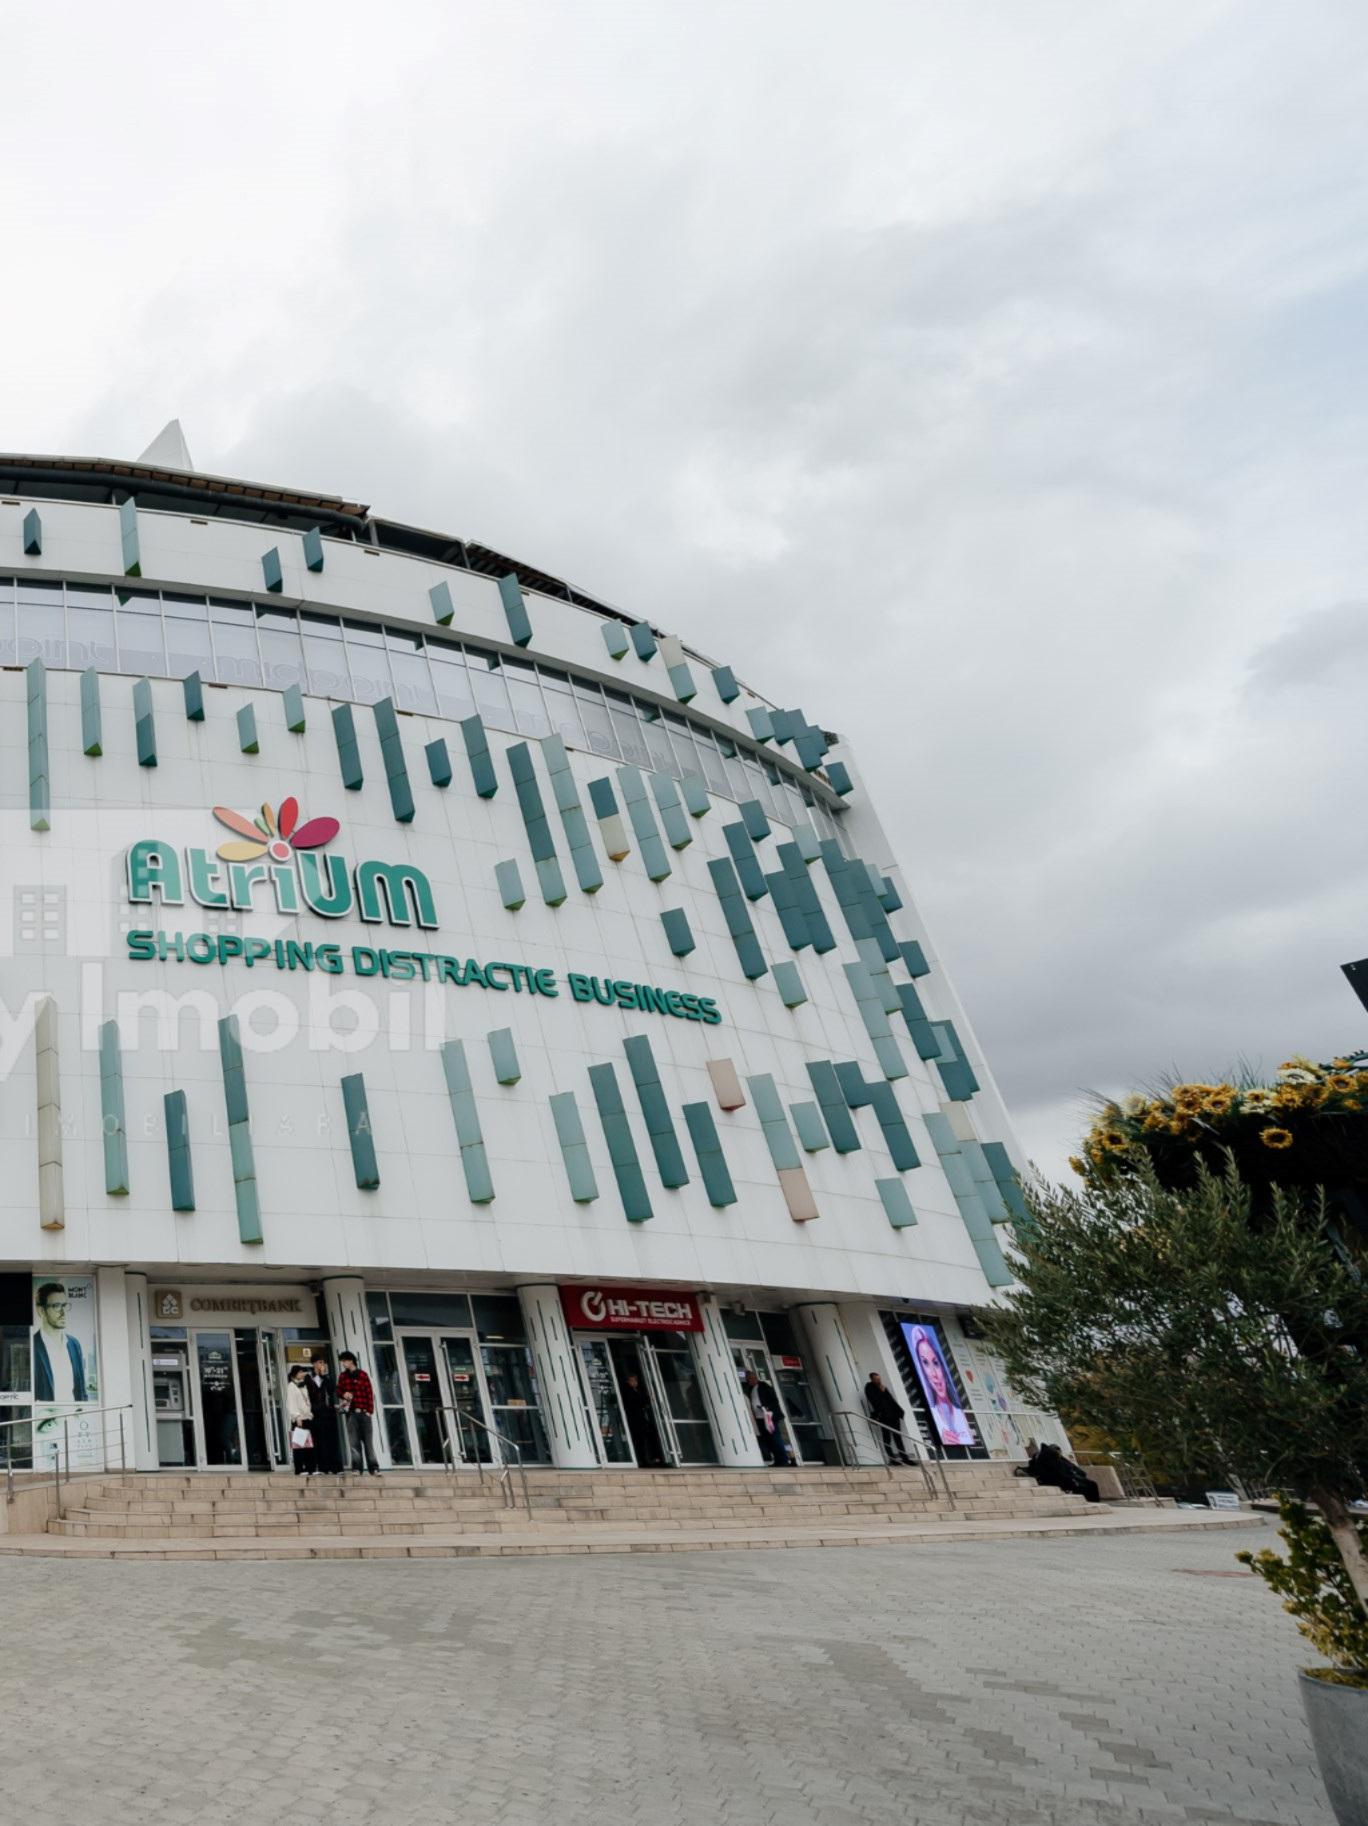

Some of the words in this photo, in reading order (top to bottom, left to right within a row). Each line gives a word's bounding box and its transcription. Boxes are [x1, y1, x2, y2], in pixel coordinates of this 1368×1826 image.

[127, 929, 344, 974] SHOPPING
[352, 946, 559, 997] DISTRACTIE
[567, 972, 722, 1025] BUSINESS
[607, 1299, 693, 1319] HI-TECH
